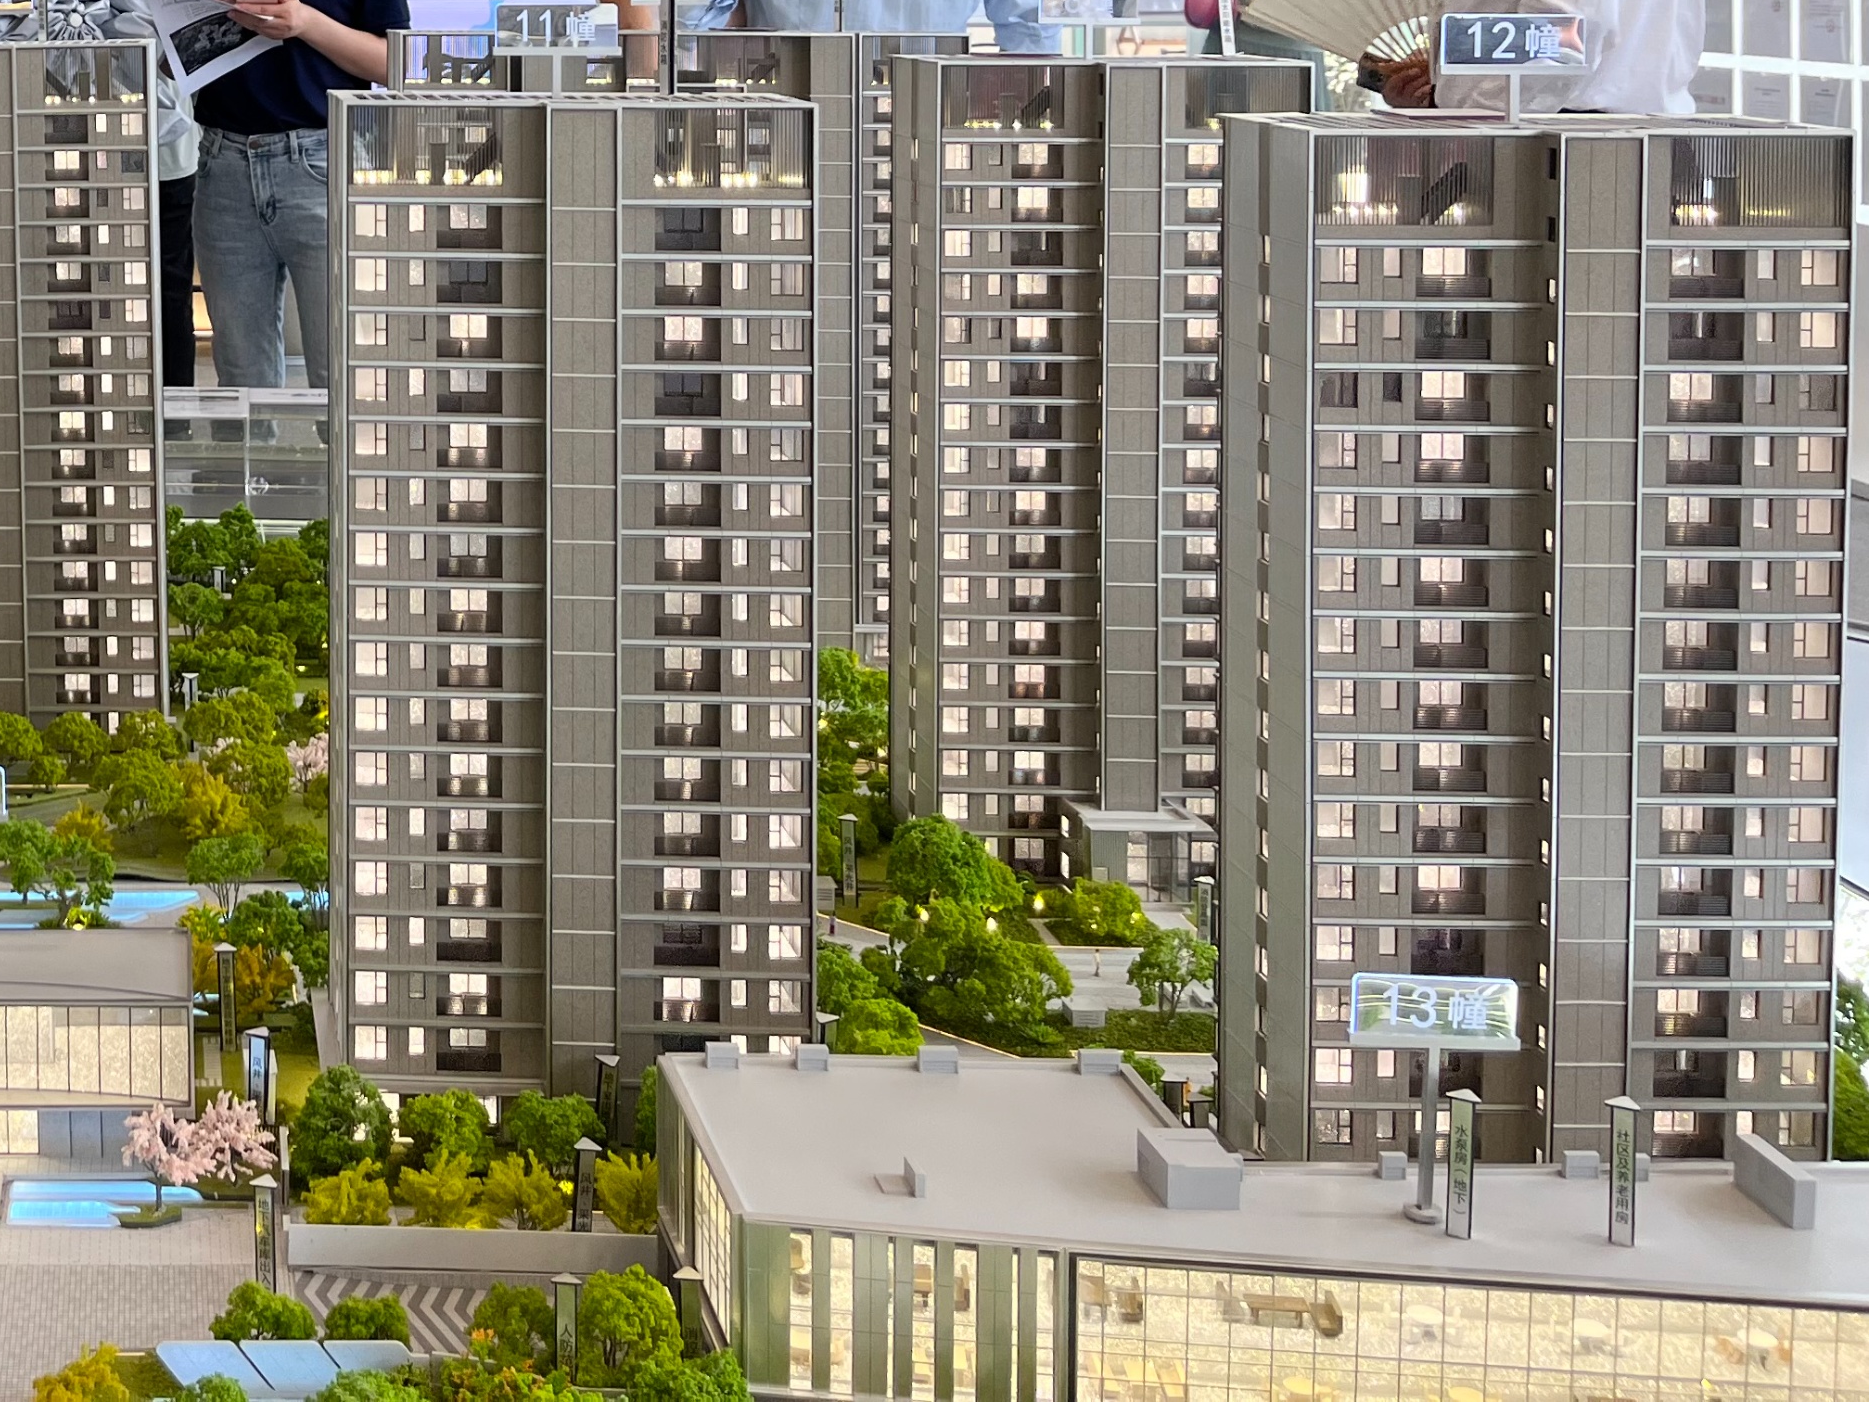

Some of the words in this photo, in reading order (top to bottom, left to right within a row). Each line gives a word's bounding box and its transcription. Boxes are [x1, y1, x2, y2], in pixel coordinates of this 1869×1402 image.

[516, 9, 597, 47] 11幢
[1467, 21, 1561, 59] 12幢
[1382, 982, 1488, 1030] 13幢
[1453, 1124, 1468, 1215] 水泵房（地下）
[1615, 1129, 1630, 1225] 社区及养老用房
